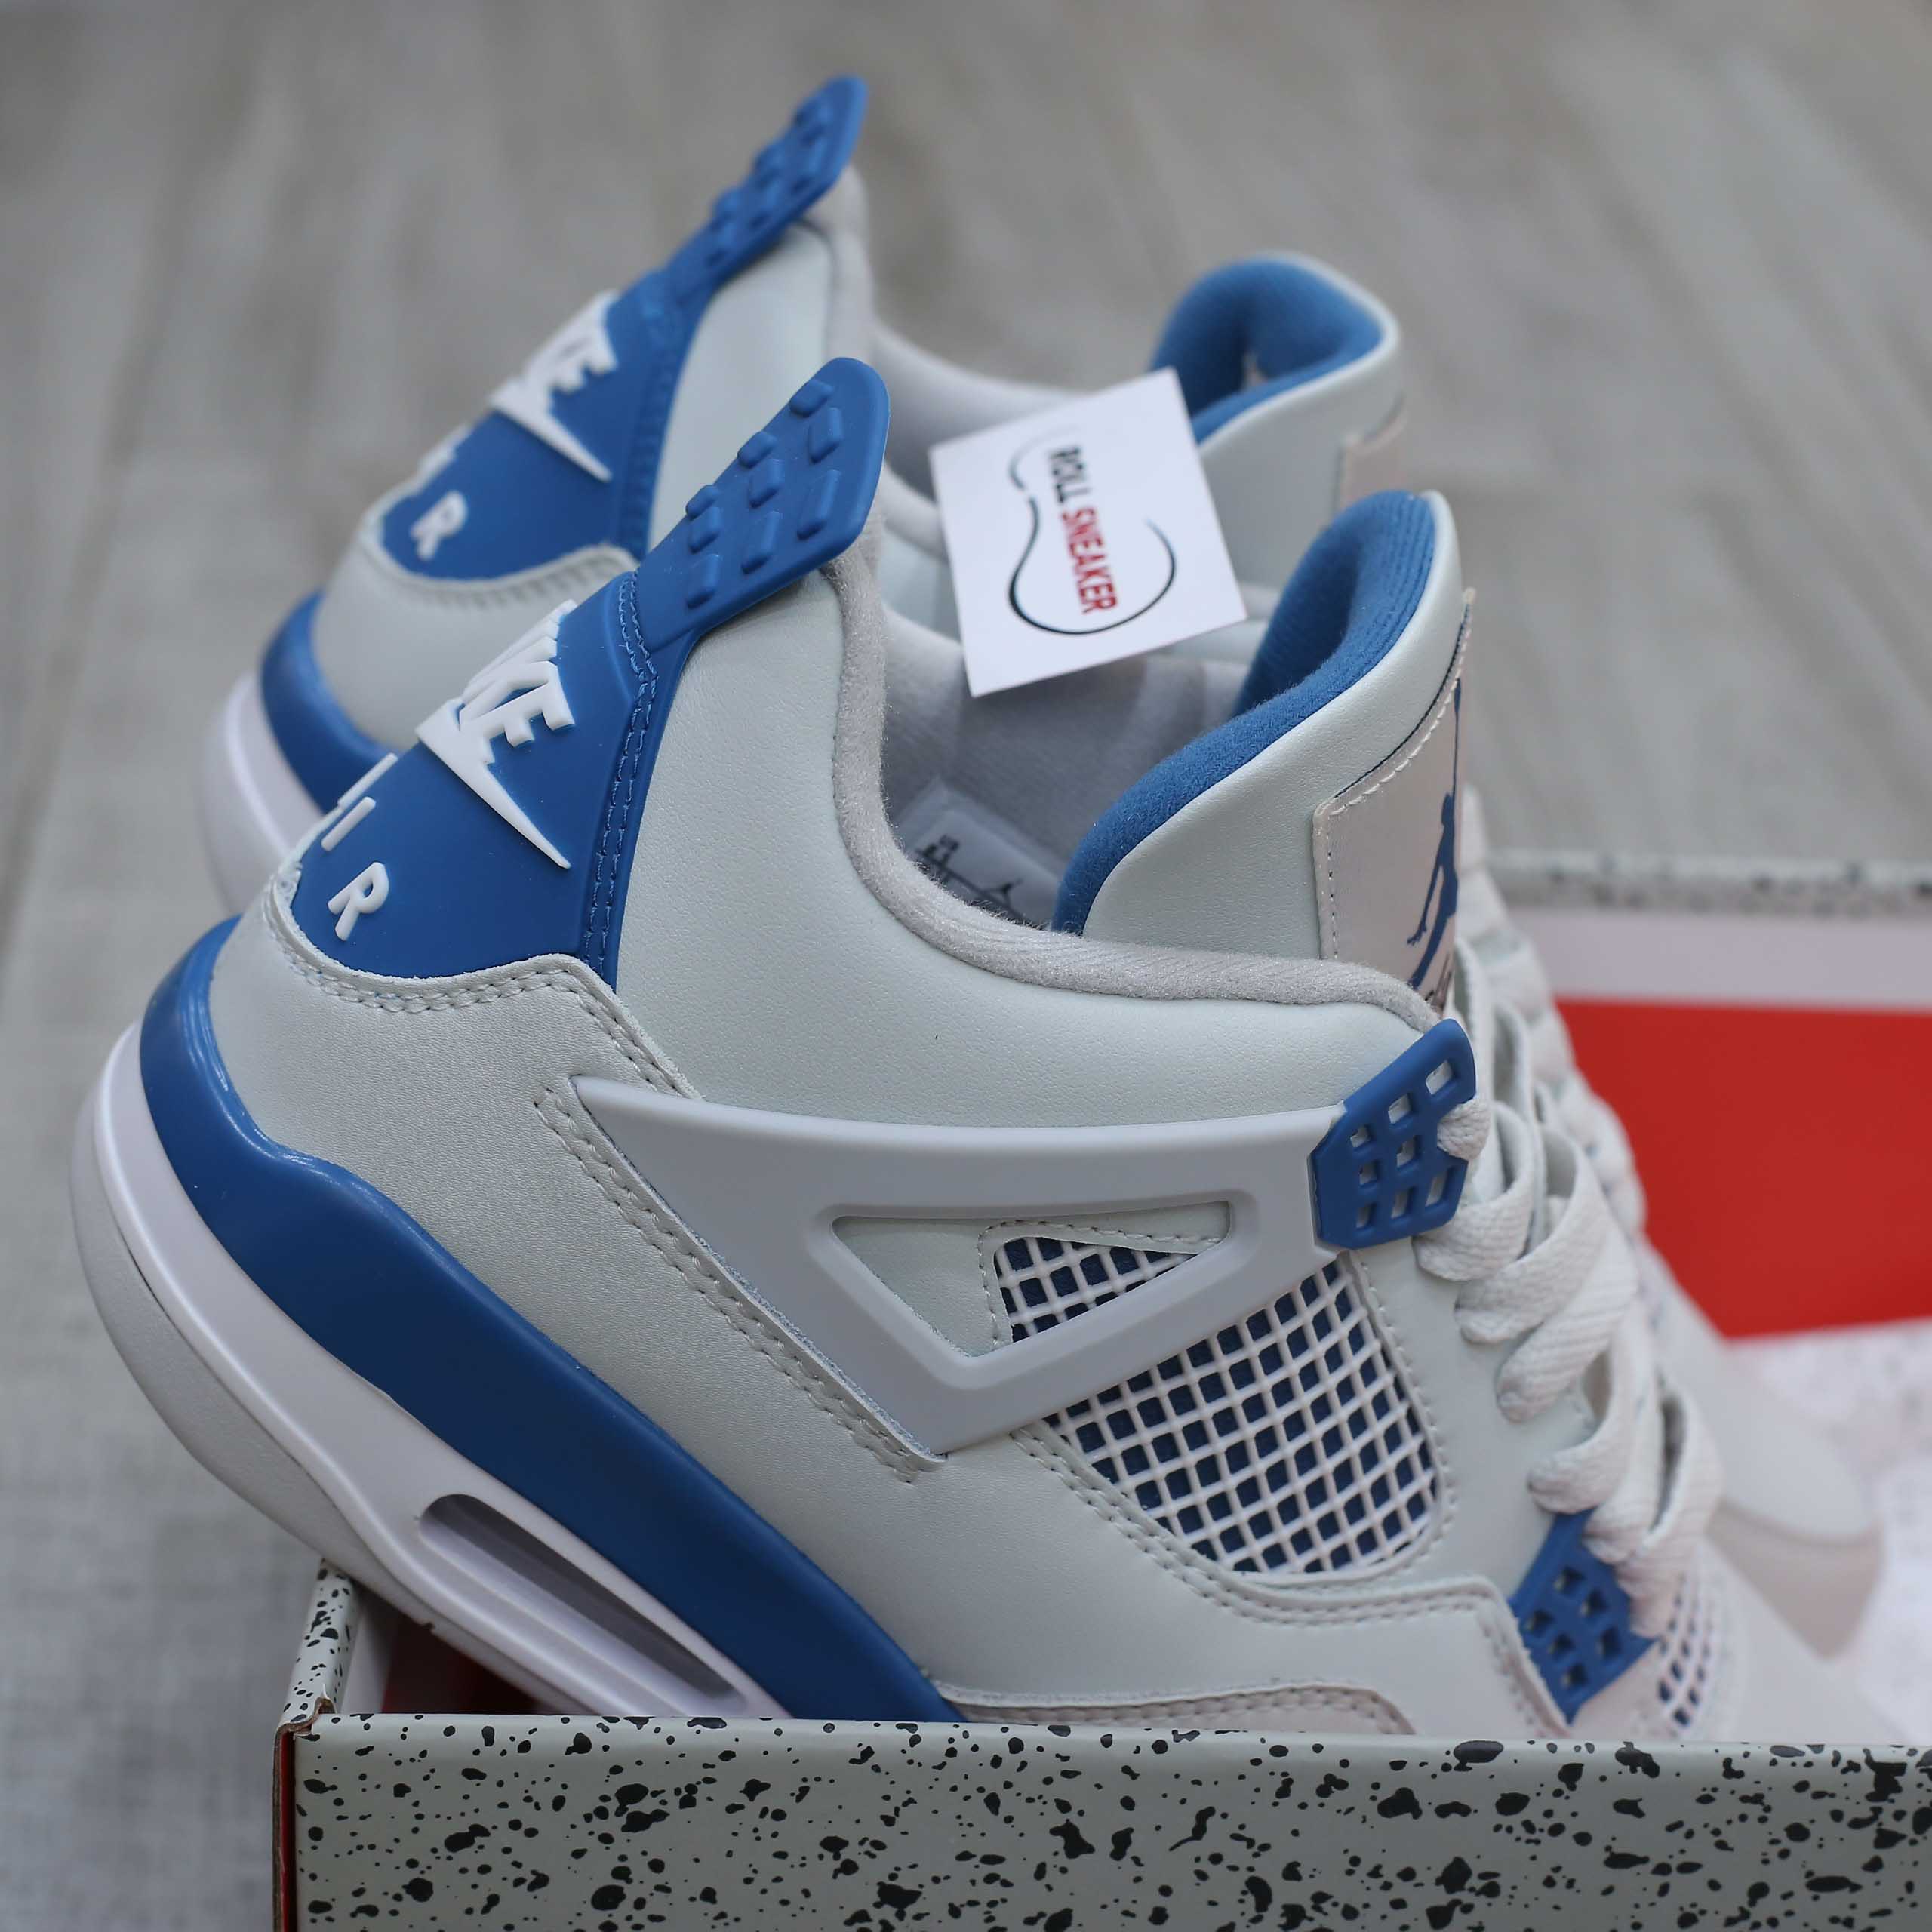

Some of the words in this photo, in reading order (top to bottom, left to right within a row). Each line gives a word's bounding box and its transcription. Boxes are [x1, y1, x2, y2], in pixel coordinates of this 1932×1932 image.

[1050, 446, 1091, 504] ROLL
[1060, 506, 1119, 615] SNEAKER
[321, 752, 398, 942] IR
